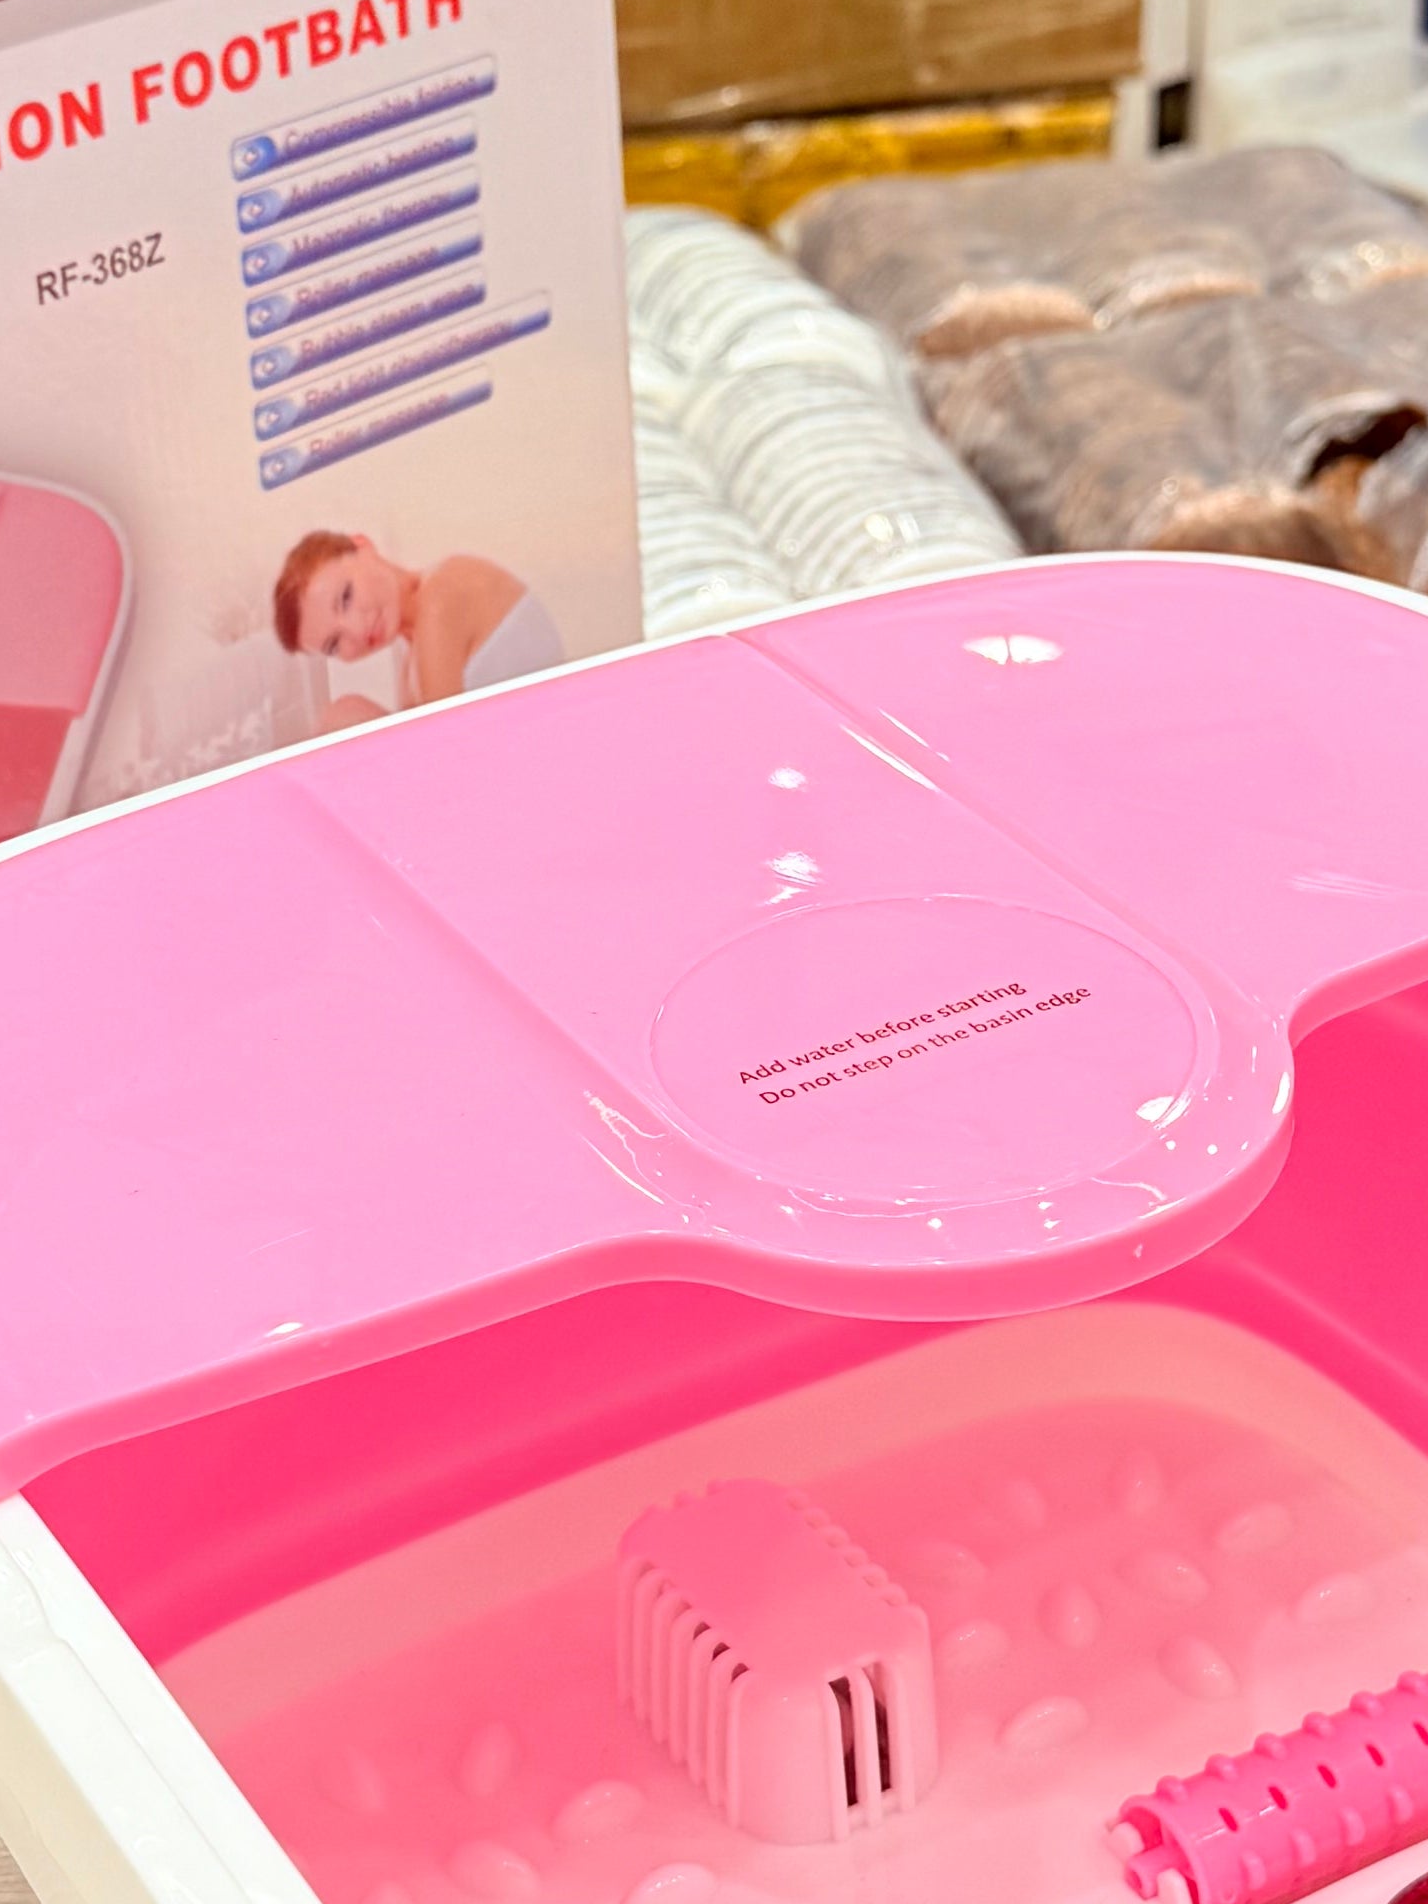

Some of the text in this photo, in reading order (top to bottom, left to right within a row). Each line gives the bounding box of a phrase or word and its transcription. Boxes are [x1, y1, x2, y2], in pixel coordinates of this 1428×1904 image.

[35, 231, 166, 307] RF-368Z
[739, 981, 1027, 1085] Add water before starting
[758, 985, 1092, 1105] Do not step on the basin edge
